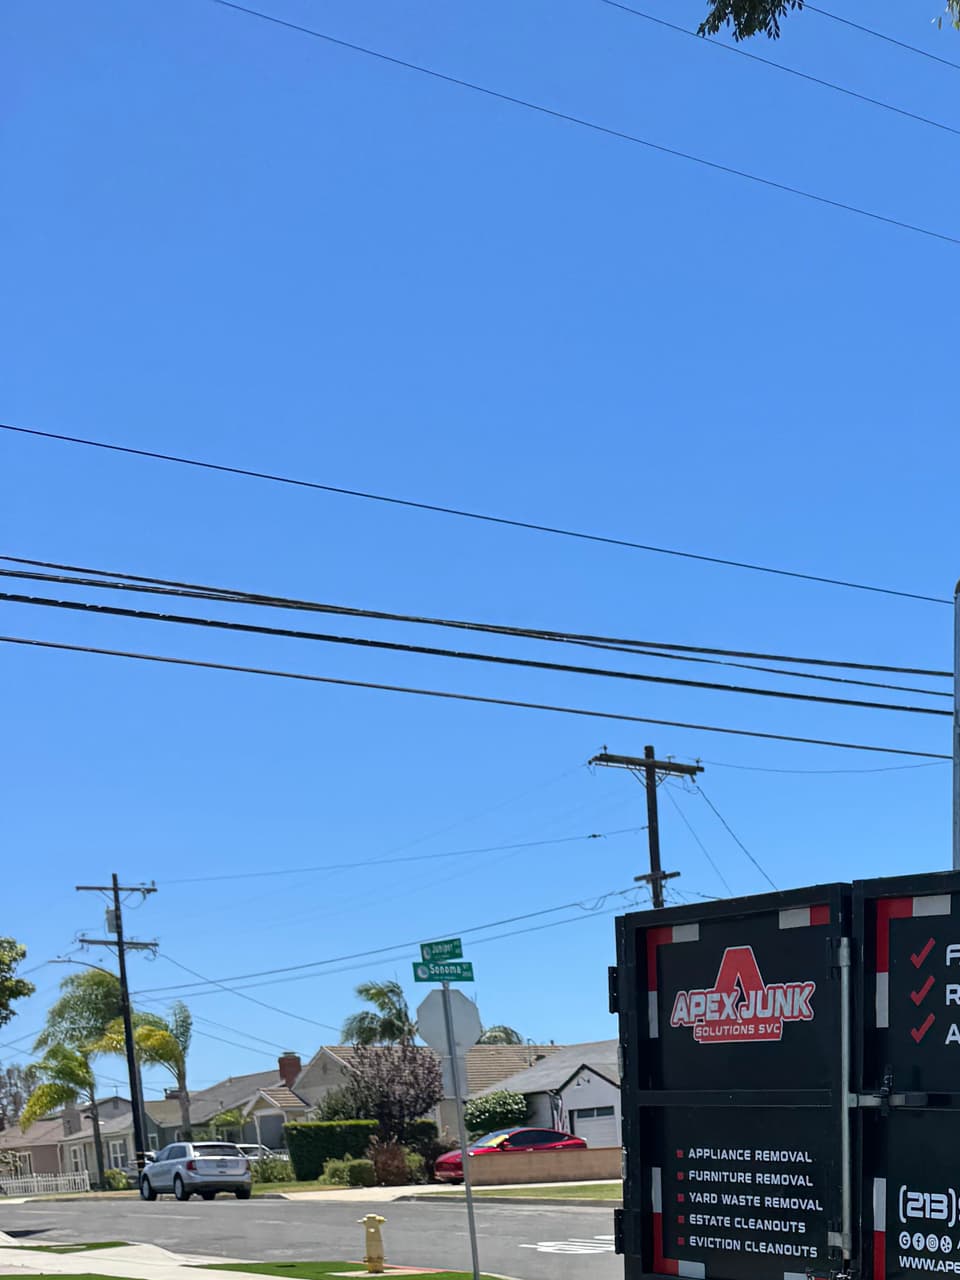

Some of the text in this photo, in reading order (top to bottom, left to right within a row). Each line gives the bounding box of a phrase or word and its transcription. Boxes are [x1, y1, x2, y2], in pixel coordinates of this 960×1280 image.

[429, 963, 462, 975] Sonoma
[673, 986, 813, 1024] APEX JUNK
[695, 1022, 782, 1038] SOLUTIONS SVC
[688, 1147, 813, 1163] APPLIANCE REMOVAL
[688, 1169, 814, 1187] FURNITURE REMOVAL
[688, 1191, 824, 1211] YARD WASTE REMOVAL
[689, 1213, 806, 1234] ESTATE CLEANOUTS
[689, 1235, 818, 1258] EVICTION CLEANOUTS
